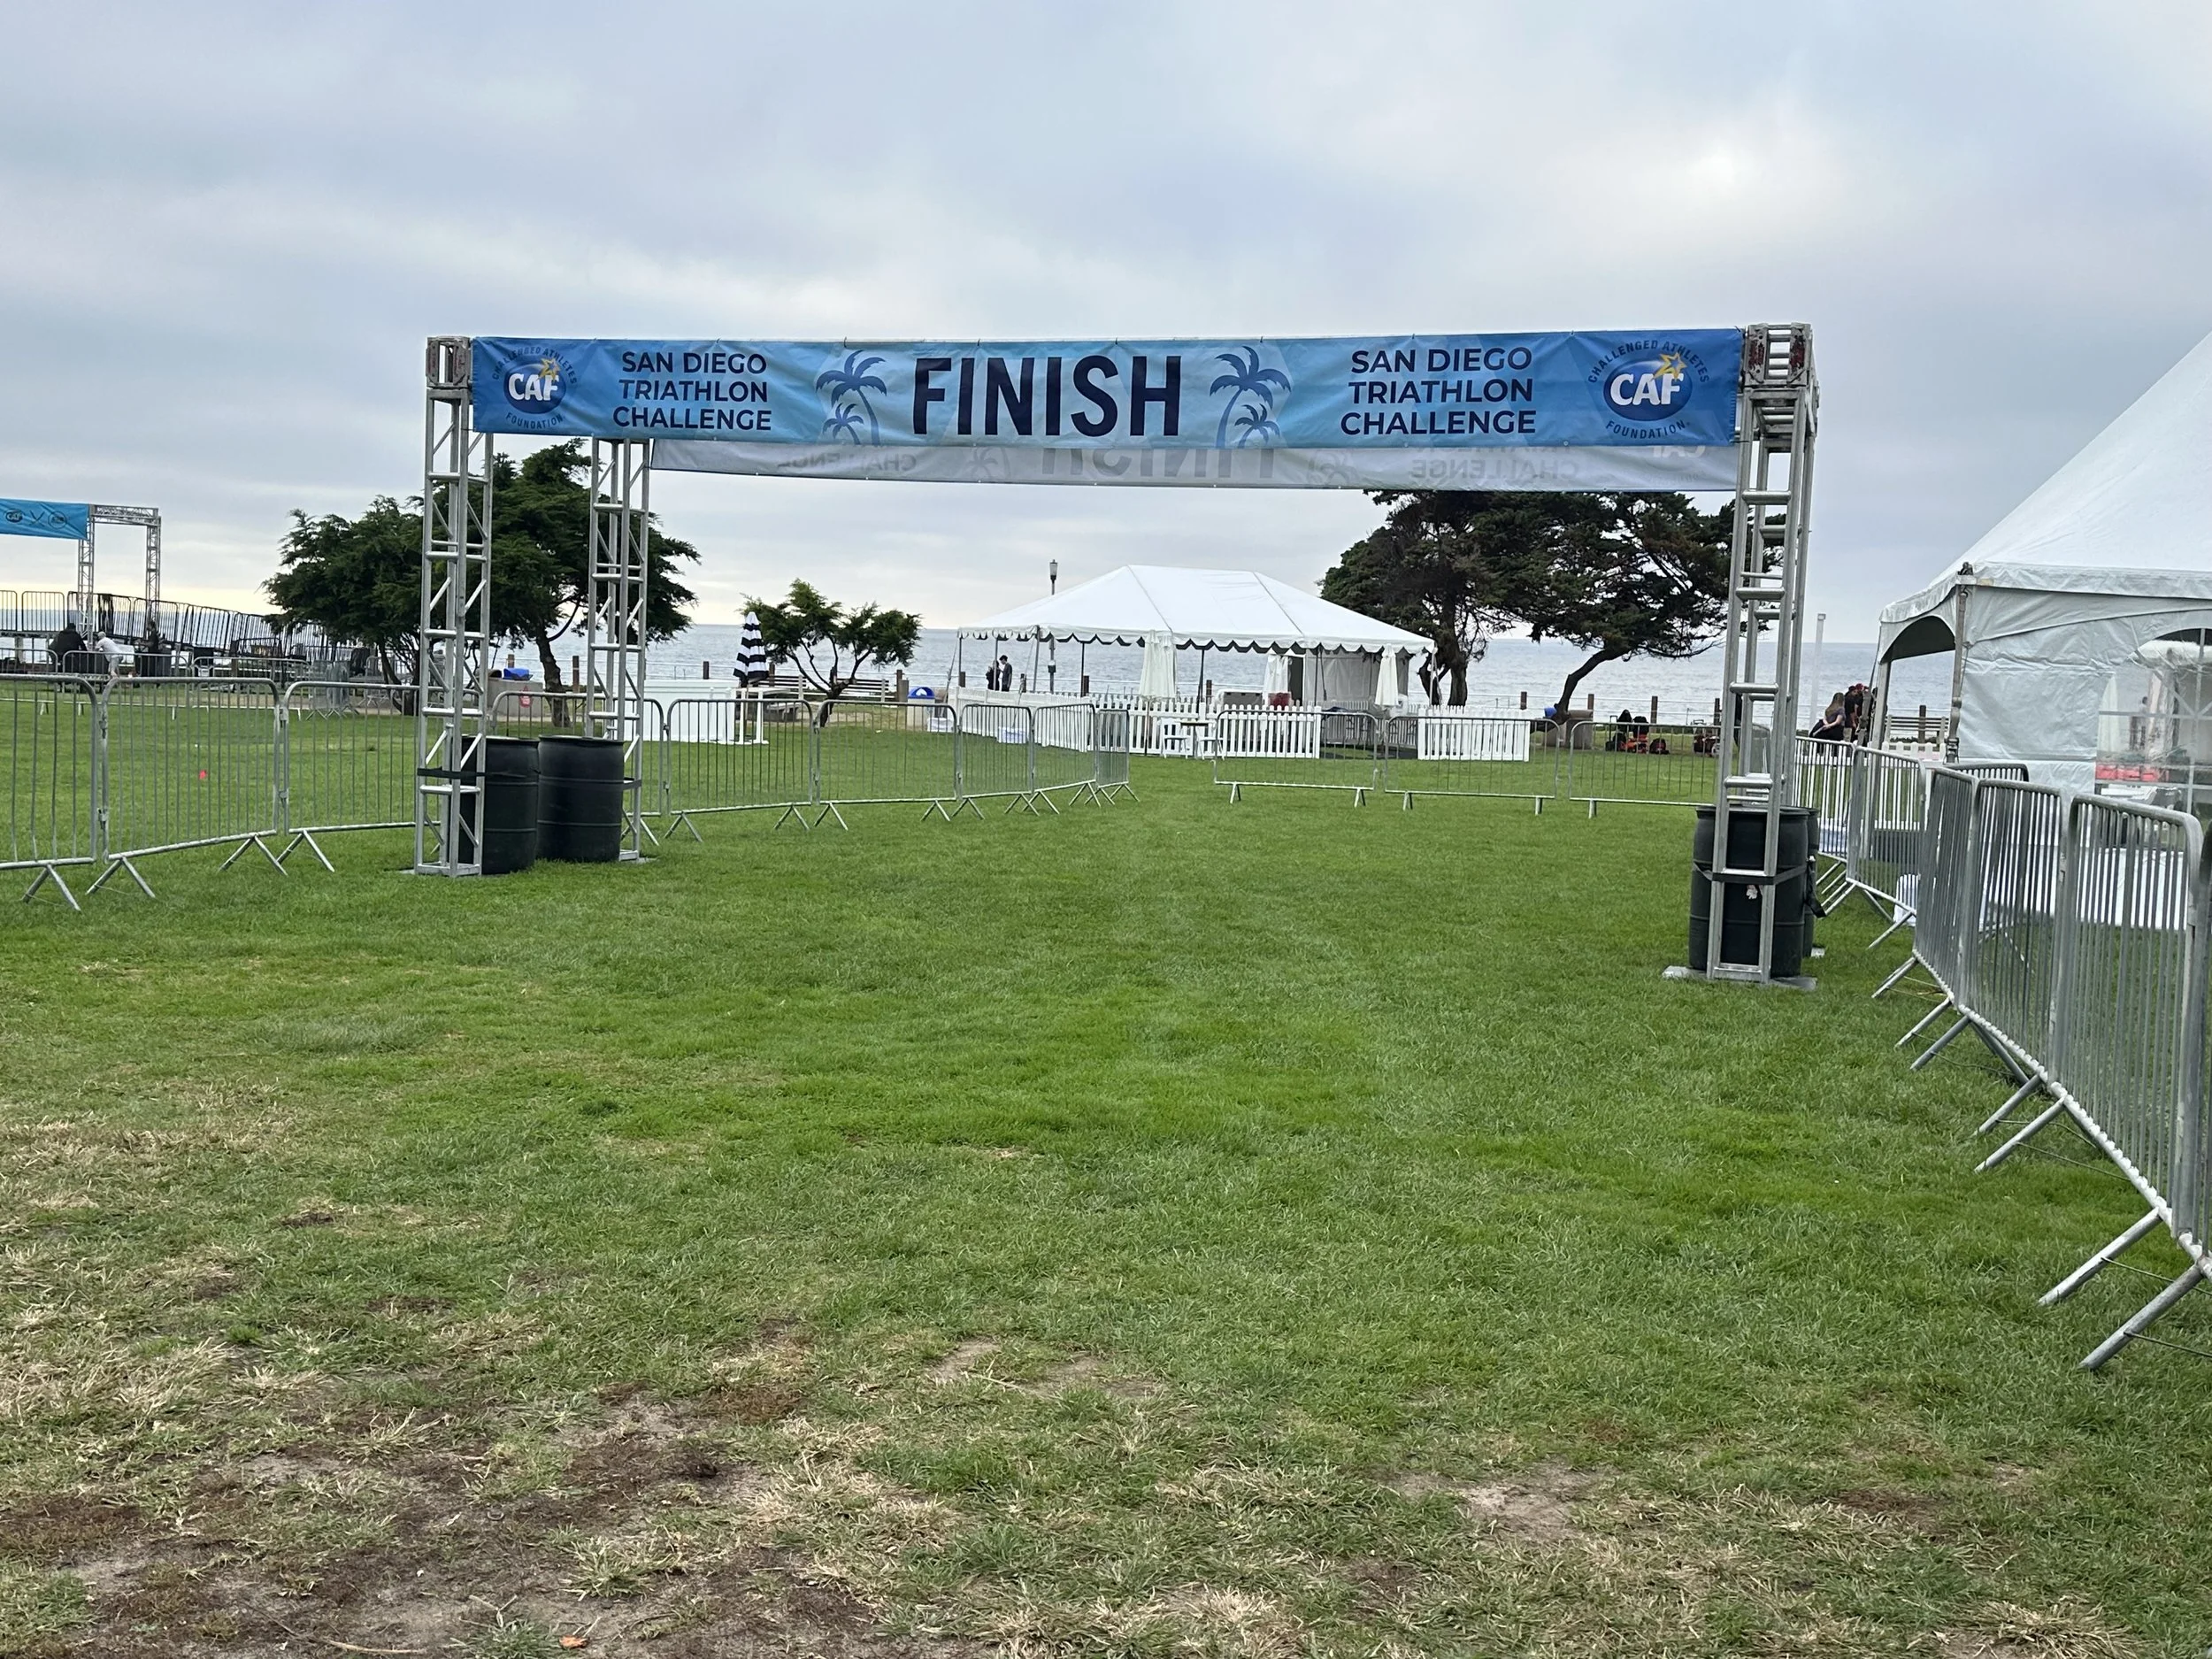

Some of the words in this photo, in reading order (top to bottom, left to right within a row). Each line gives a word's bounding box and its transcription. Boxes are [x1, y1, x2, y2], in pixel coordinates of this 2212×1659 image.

[543, 348, 577, 384] ATHLETES
[622, 351, 674, 373] SAN
[683, 353, 767, 374] DIEGO
[1350, 349, 1416, 373] SAN
[1427, 347, 1532, 371] DIEGO
[1587, 340, 1658, 383] CHALLENGED
[1663, 341, 1709, 382] ATHLETES
[509, 373, 560, 401] CAF
[621, 380, 768, 403] TRIATHLON
[913, 355, 1182, 437] FINISH
[1348, 378, 1532, 405] TRIATHLON
[1610, 373, 1685, 406] CAF
[505, 411, 563, 429] FOUNDATION
[613, 405, 772, 431] CHALLENGE
[1340, 410, 1537, 434] CHALLENGE
[1605, 419, 1686, 439] FOUNDATION
